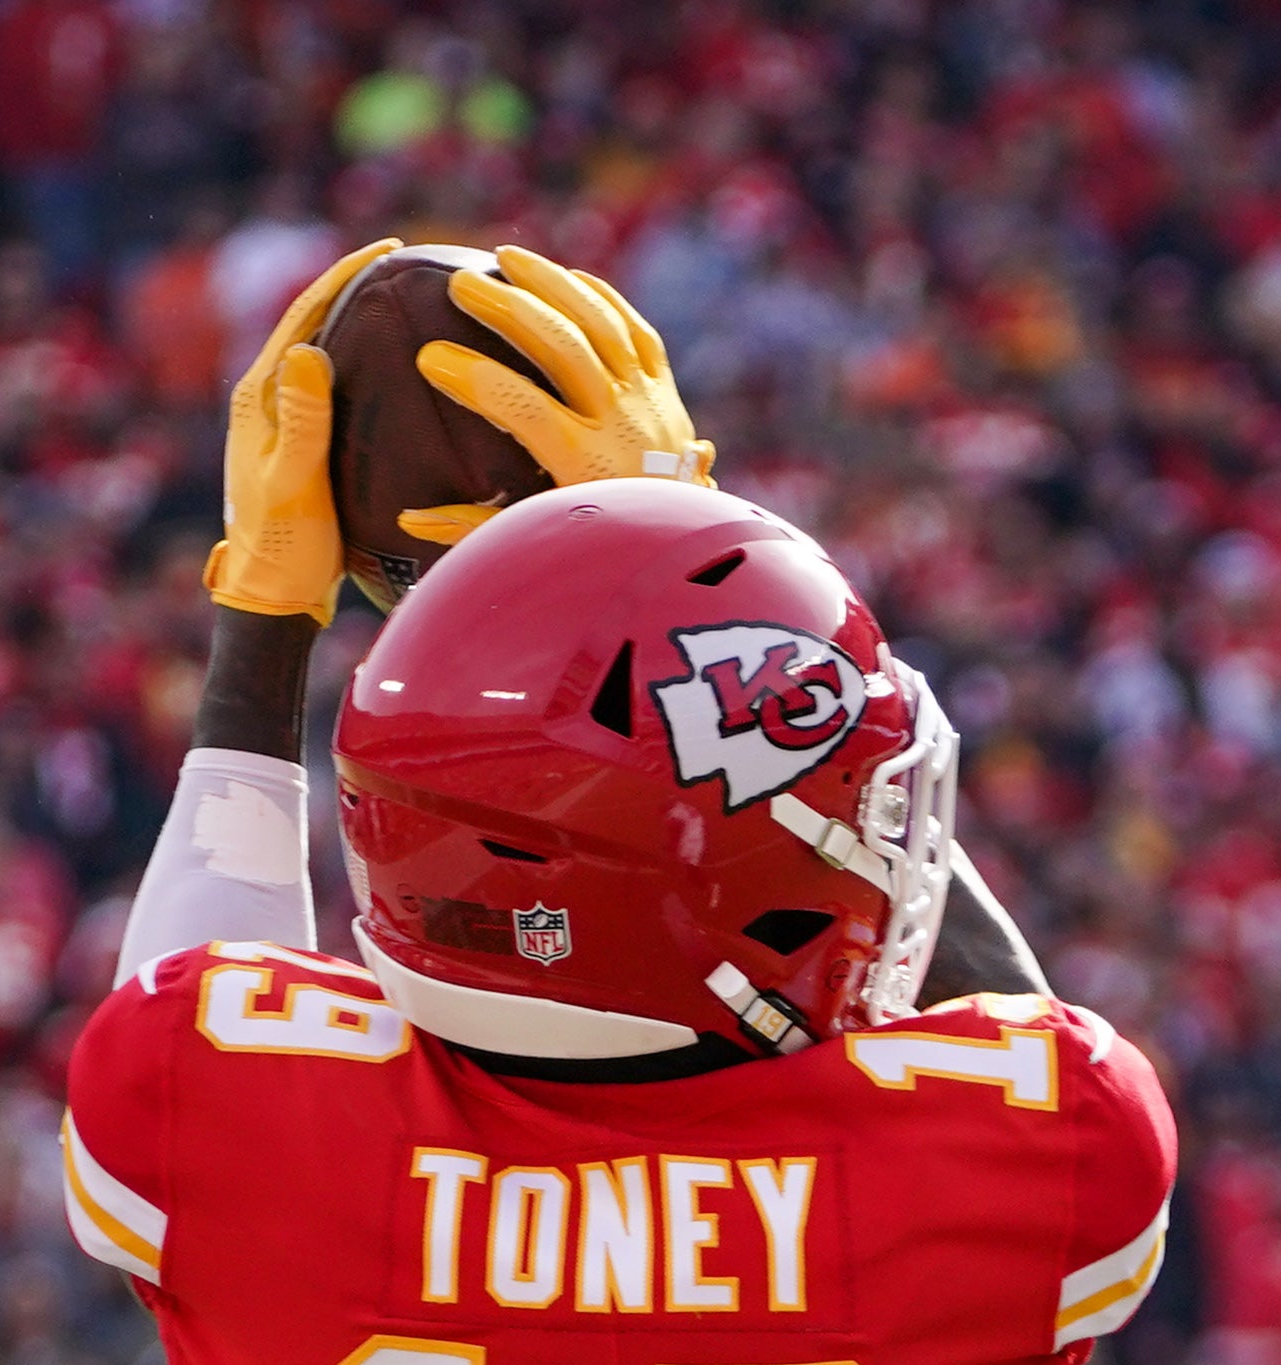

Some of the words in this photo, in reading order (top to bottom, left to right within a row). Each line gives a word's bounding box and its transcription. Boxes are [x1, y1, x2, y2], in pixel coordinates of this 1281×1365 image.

[701, 641, 849, 751] KC
[522, 931, 564, 955] NFL
[751, 1005, 785, 1037] 19
[844, 992, 1059, 1112] 1
[410, 1146, 817, 1314] TONEY
